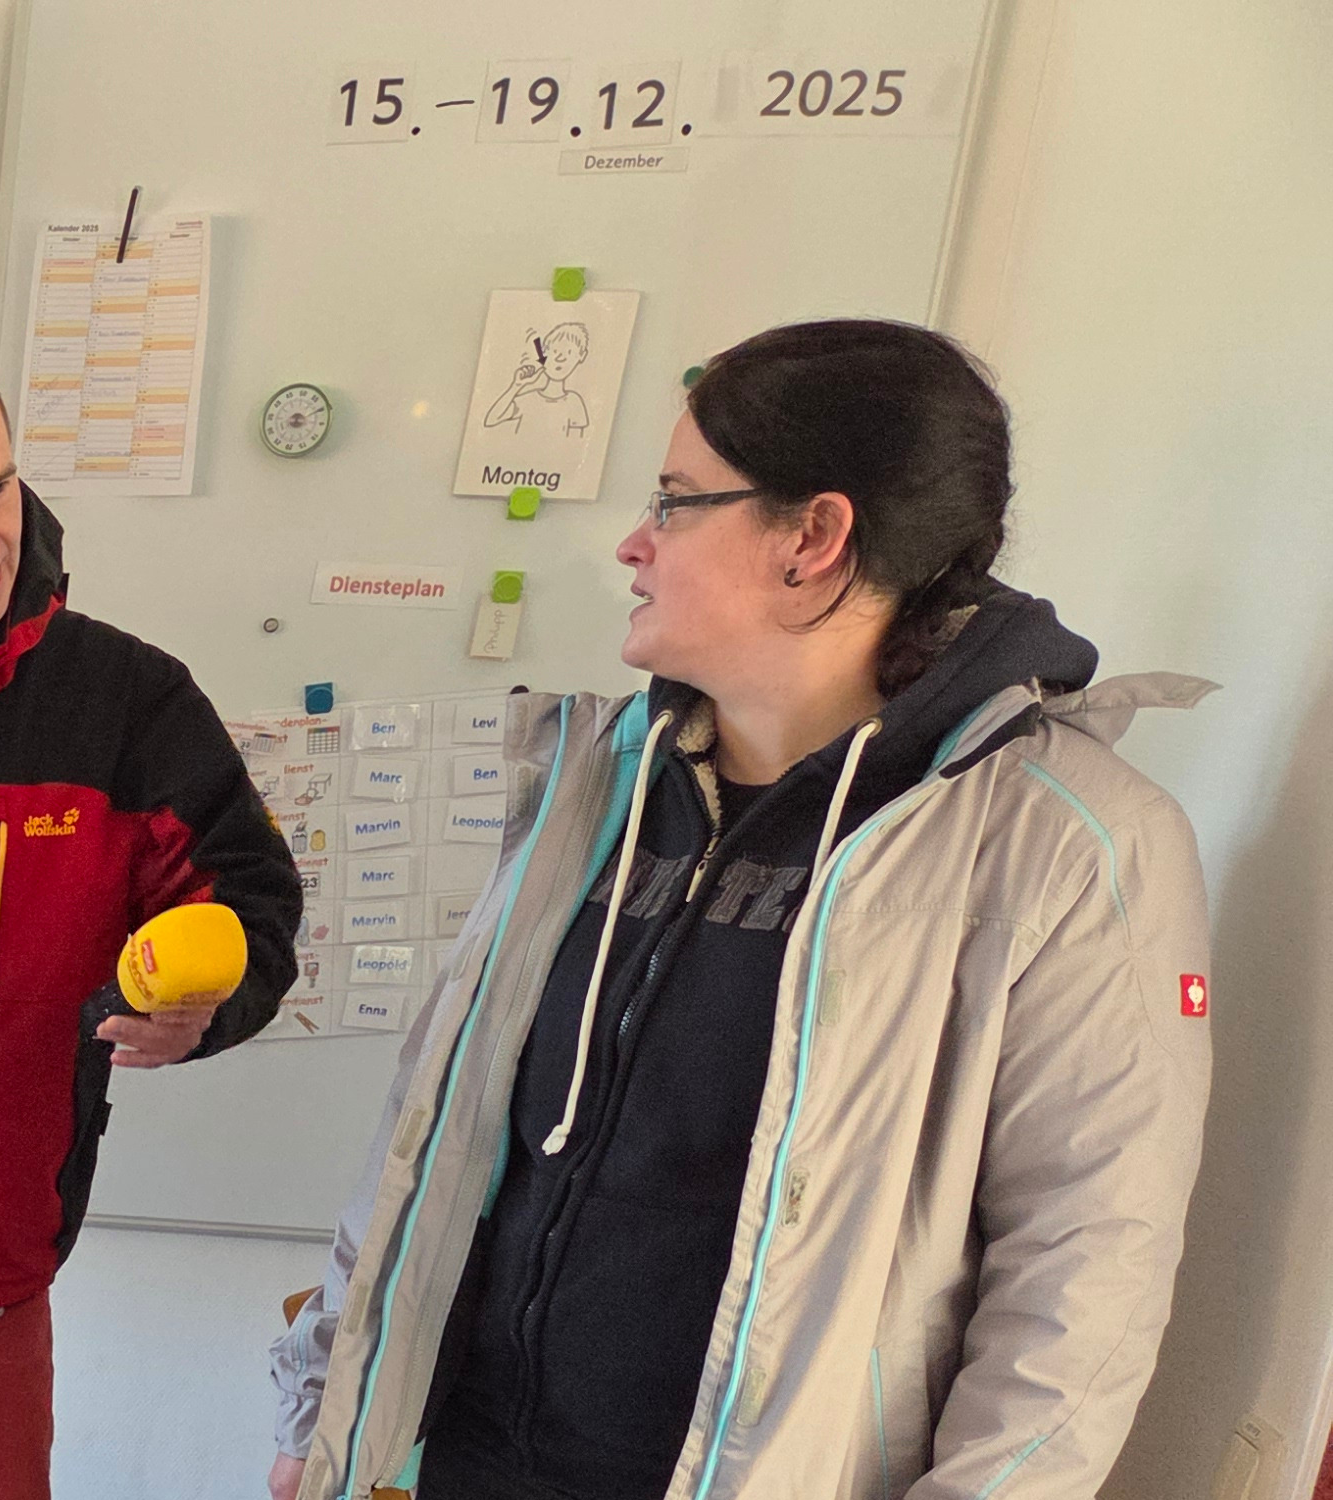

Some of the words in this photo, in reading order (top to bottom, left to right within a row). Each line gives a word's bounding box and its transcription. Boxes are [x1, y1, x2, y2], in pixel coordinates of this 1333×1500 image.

[759, 69, 907, 117] 2025
[583, 154, 664, 170] Dezember
[47, 223, 80, 232] Kalender
[482, 466, 562, 491] Montag
[329, 576, 445, 600] Diensteplan
[371, 722, 396, 734] Ben
[472, 716, 498, 729] Levi
[370, 771, 402, 784] Marc
[473, 769, 498, 781] Ben
[24, 814, 54, 826] Jack
[355, 818, 401, 835] Marvin
[452, 814, 504, 829] Leopold
[23, 824, 76, 837] Wolfskin
[361, 871, 395, 882] Marc
[357, 958, 408, 972] Leopold
[358, 1003, 388, 1017] Enna
